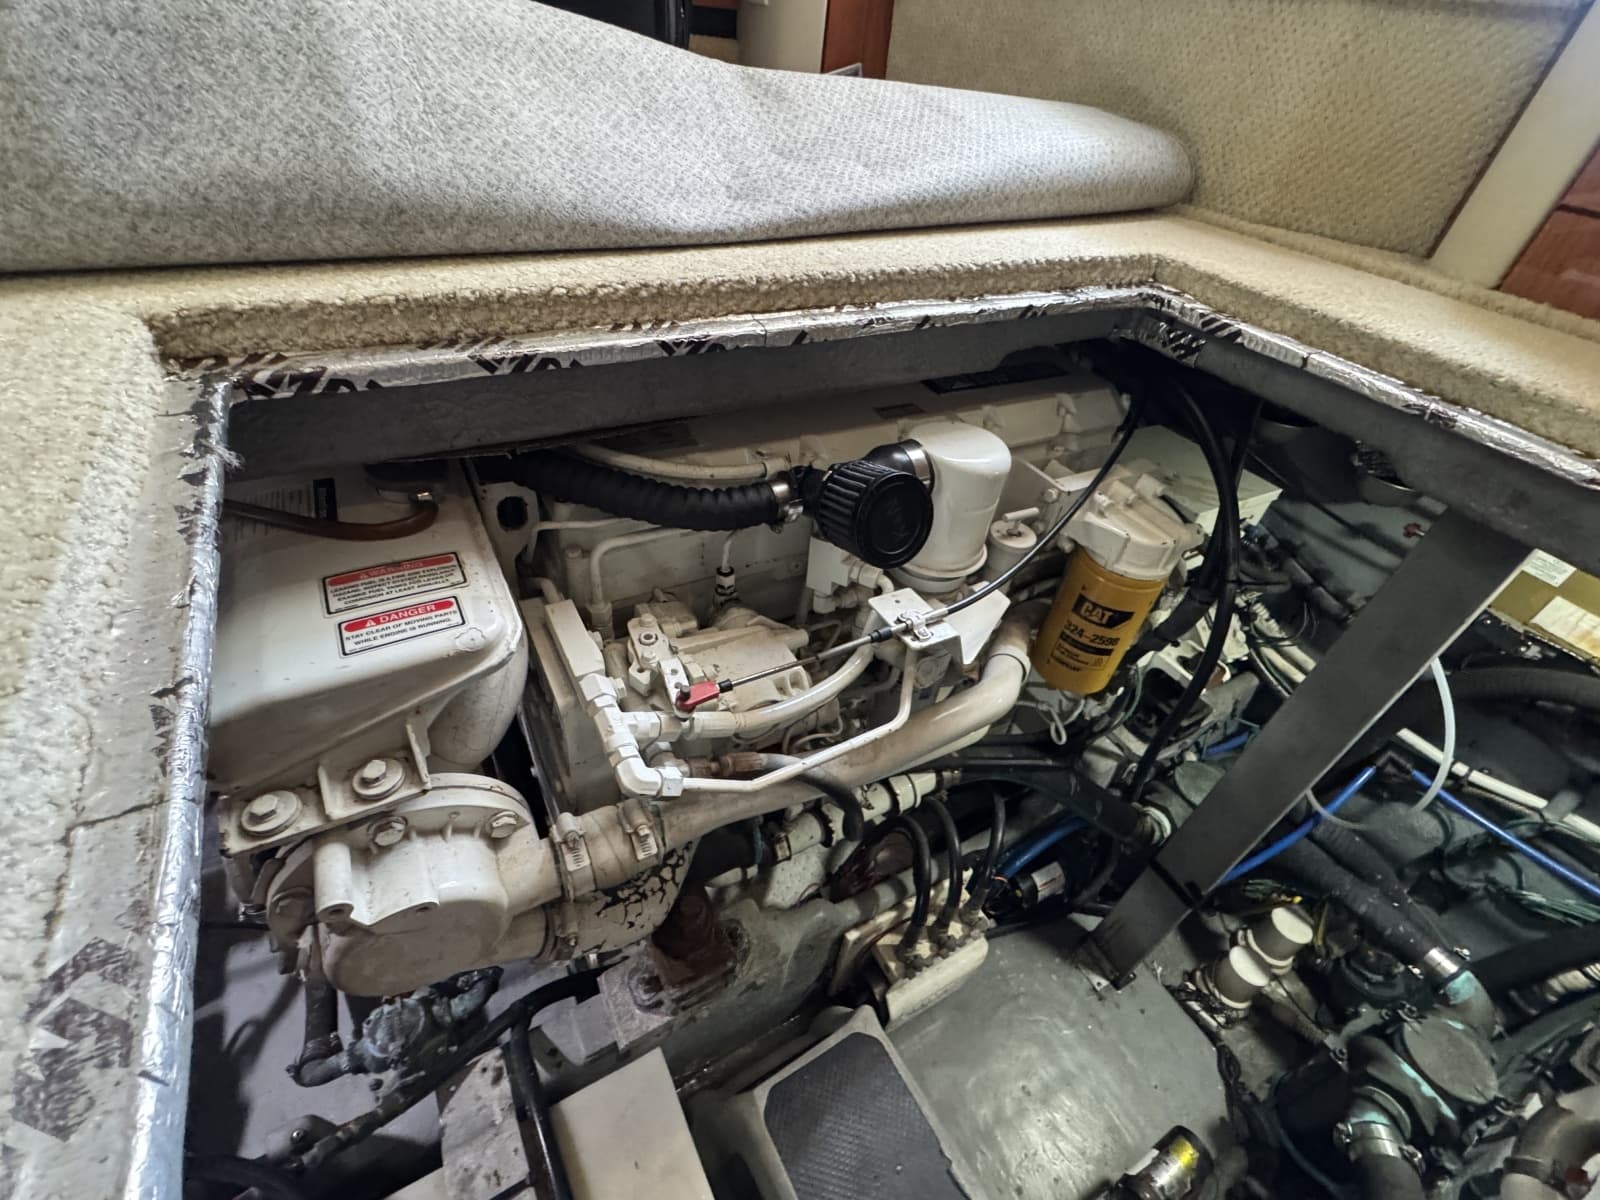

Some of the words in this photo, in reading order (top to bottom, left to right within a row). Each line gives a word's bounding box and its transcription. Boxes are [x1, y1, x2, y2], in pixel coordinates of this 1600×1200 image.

[379, 604, 436, 622] DANGER
[1080, 601, 1114, 624] CAT
[365, 625, 390, 636] CLEAR
